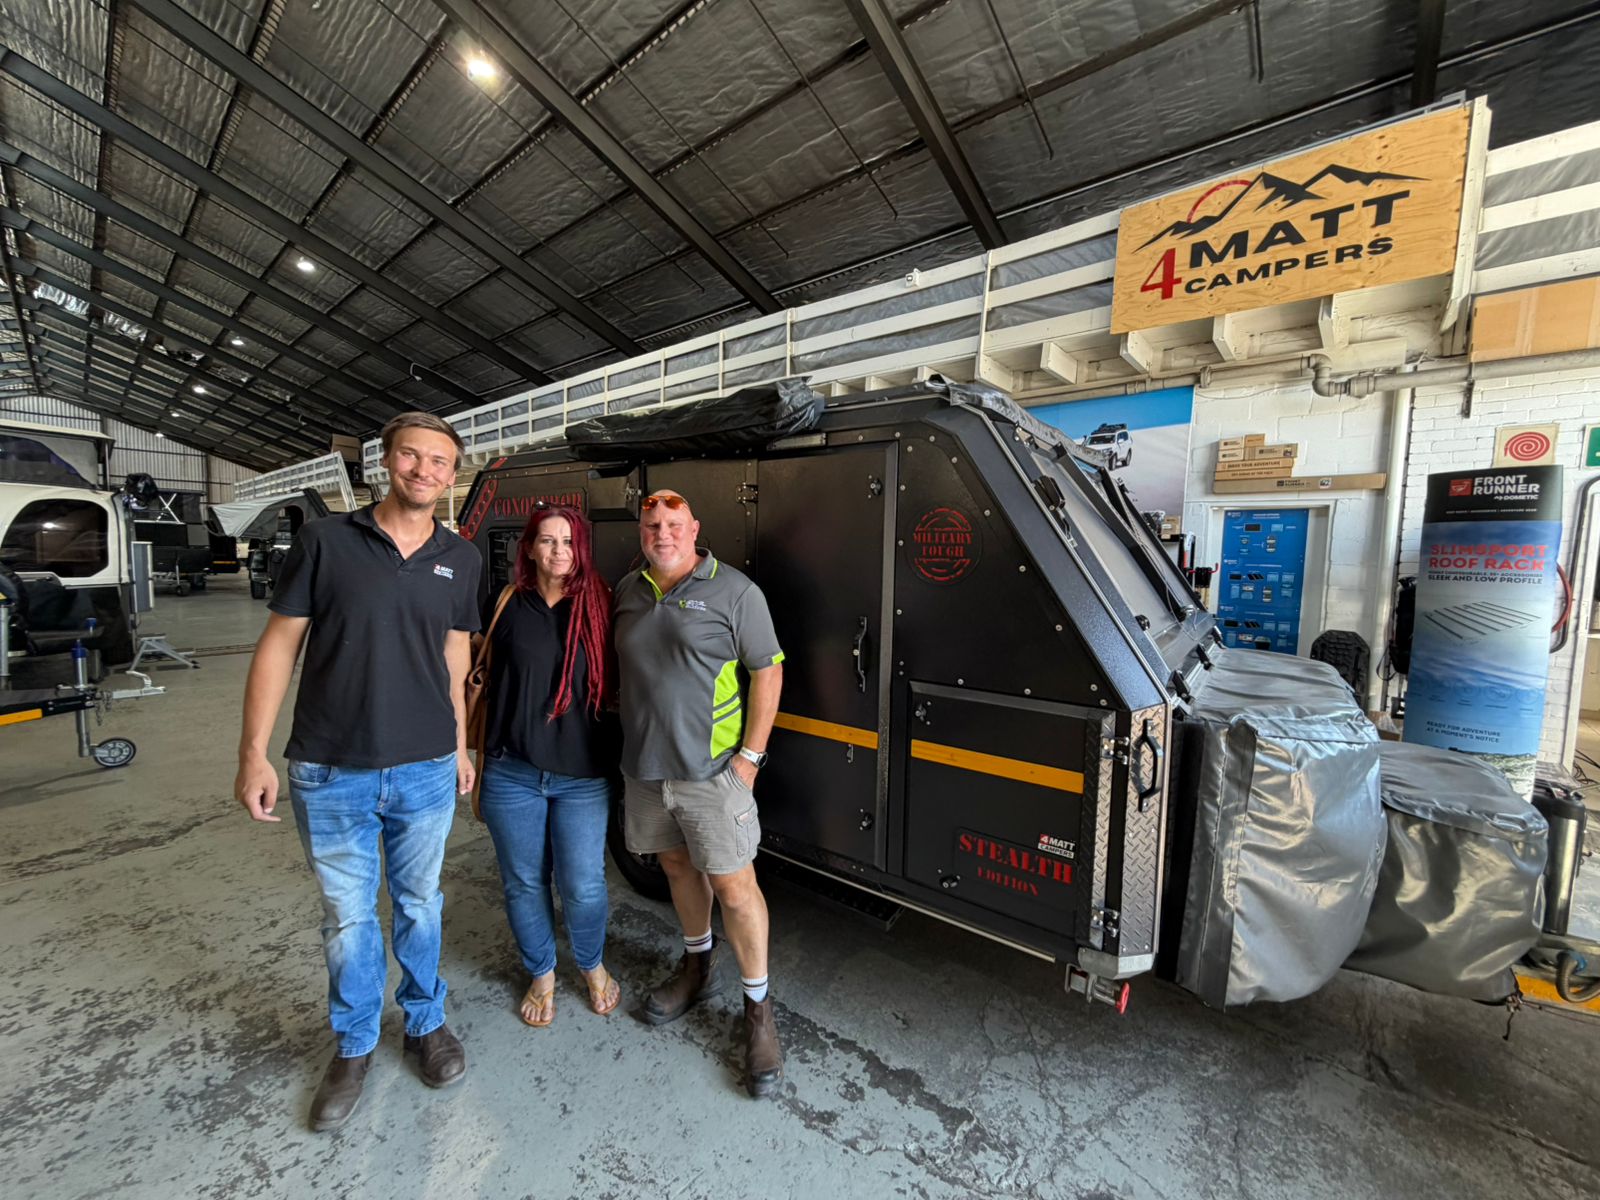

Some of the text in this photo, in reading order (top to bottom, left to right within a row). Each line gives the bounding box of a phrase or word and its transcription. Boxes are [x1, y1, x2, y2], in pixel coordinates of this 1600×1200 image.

[1185, 236, 1394, 294] CAMPERS
[1474, 474, 1527, 486] FRONT
[1472, 483, 1540, 495] RUNNER
[914, 532, 973, 544] MILITARY
[922, 545, 965, 557] TOUGH
[1430, 544, 1548, 557] SLIMSPORT
[1429, 557, 1545, 571] ROOF RACK
[1499, 576, 1543, 584] PROFILE
[1426, 720, 1446, 728] READY
[1462, 727, 1501, 737] ADVENTURE
[1441, 730, 1474, 739] MOMENT'S
[1475, 735, 1500, 743] NOTICE
[1039, 844, 1074, 858] CAMPERS
[959, 833, 1073, 885] STEALTH
